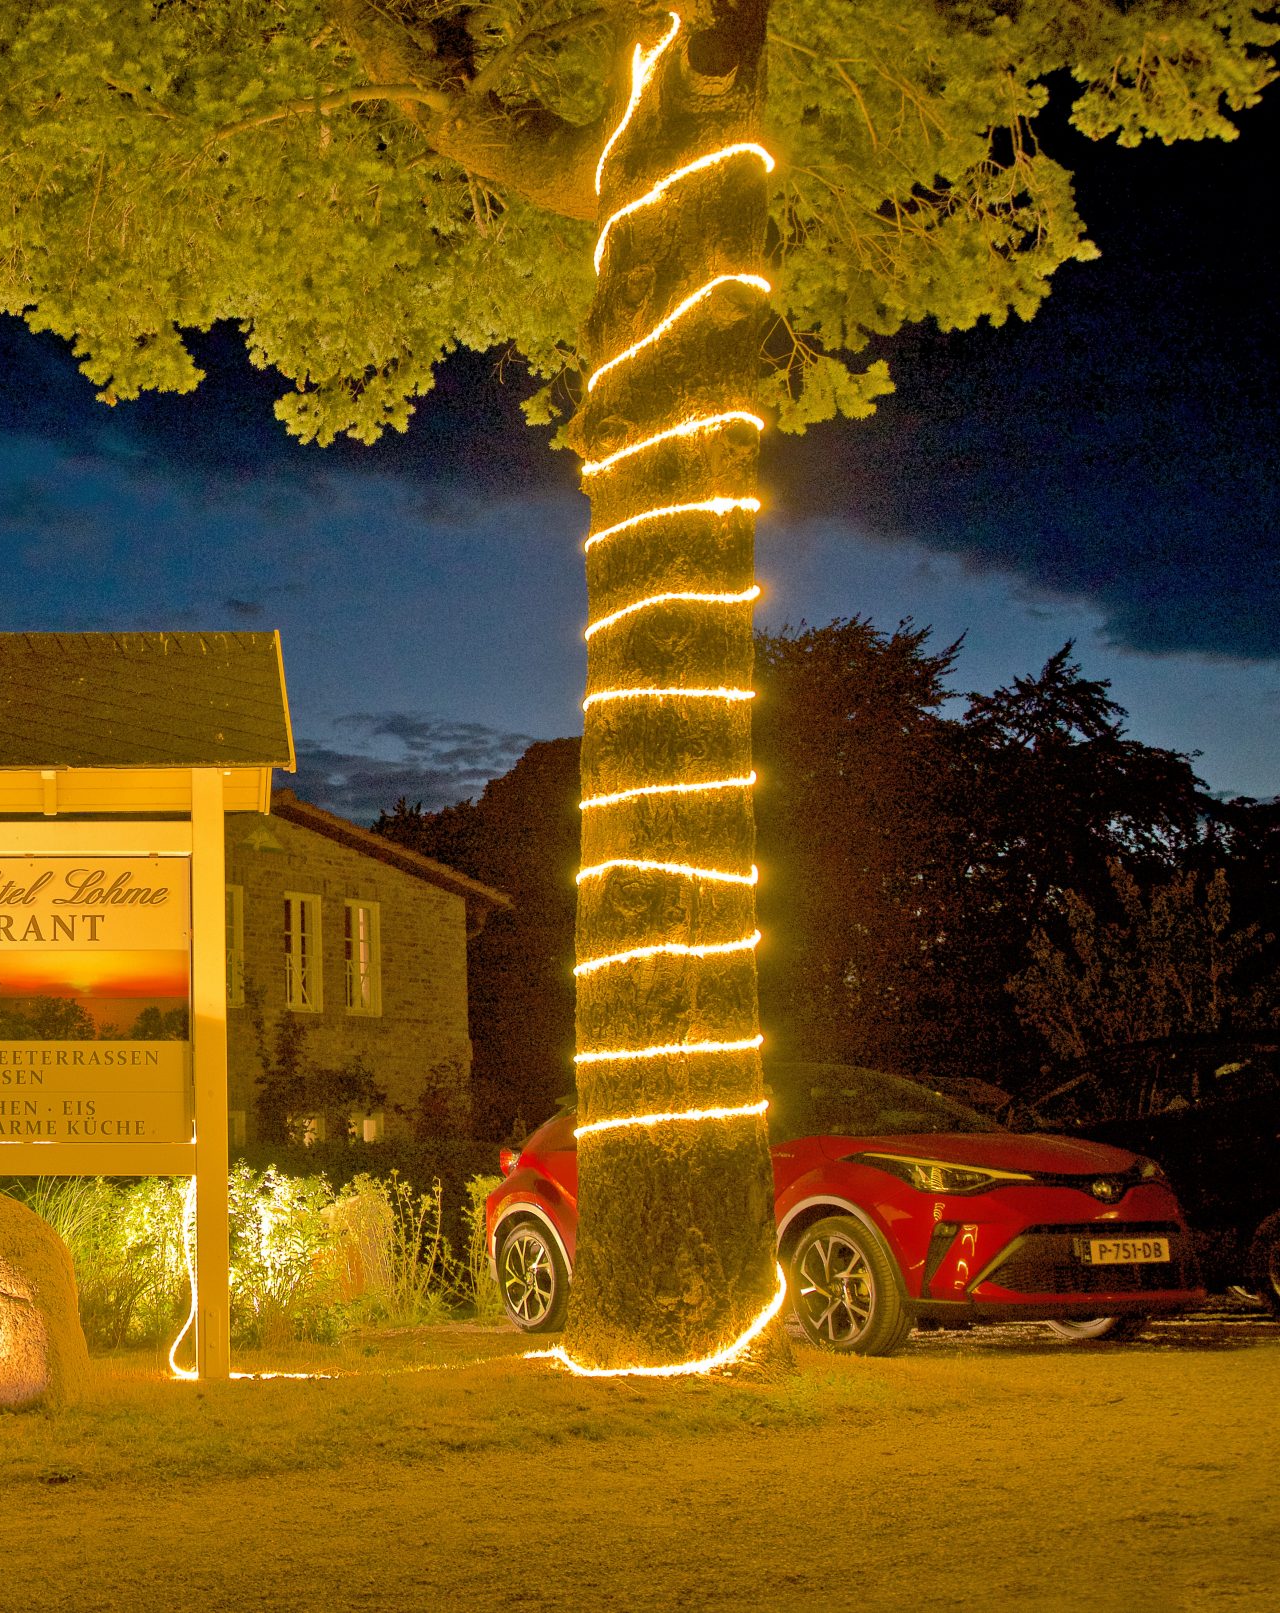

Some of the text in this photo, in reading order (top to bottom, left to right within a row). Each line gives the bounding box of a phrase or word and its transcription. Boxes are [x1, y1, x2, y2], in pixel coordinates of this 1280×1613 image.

[52, 868, 169, 906] Lohme
[63, 1100, 97, 1115] EIS
[66, 1115, 146, 1135] KÜCHE
[1098, 1242, 1162, 1260] P-751-DB
